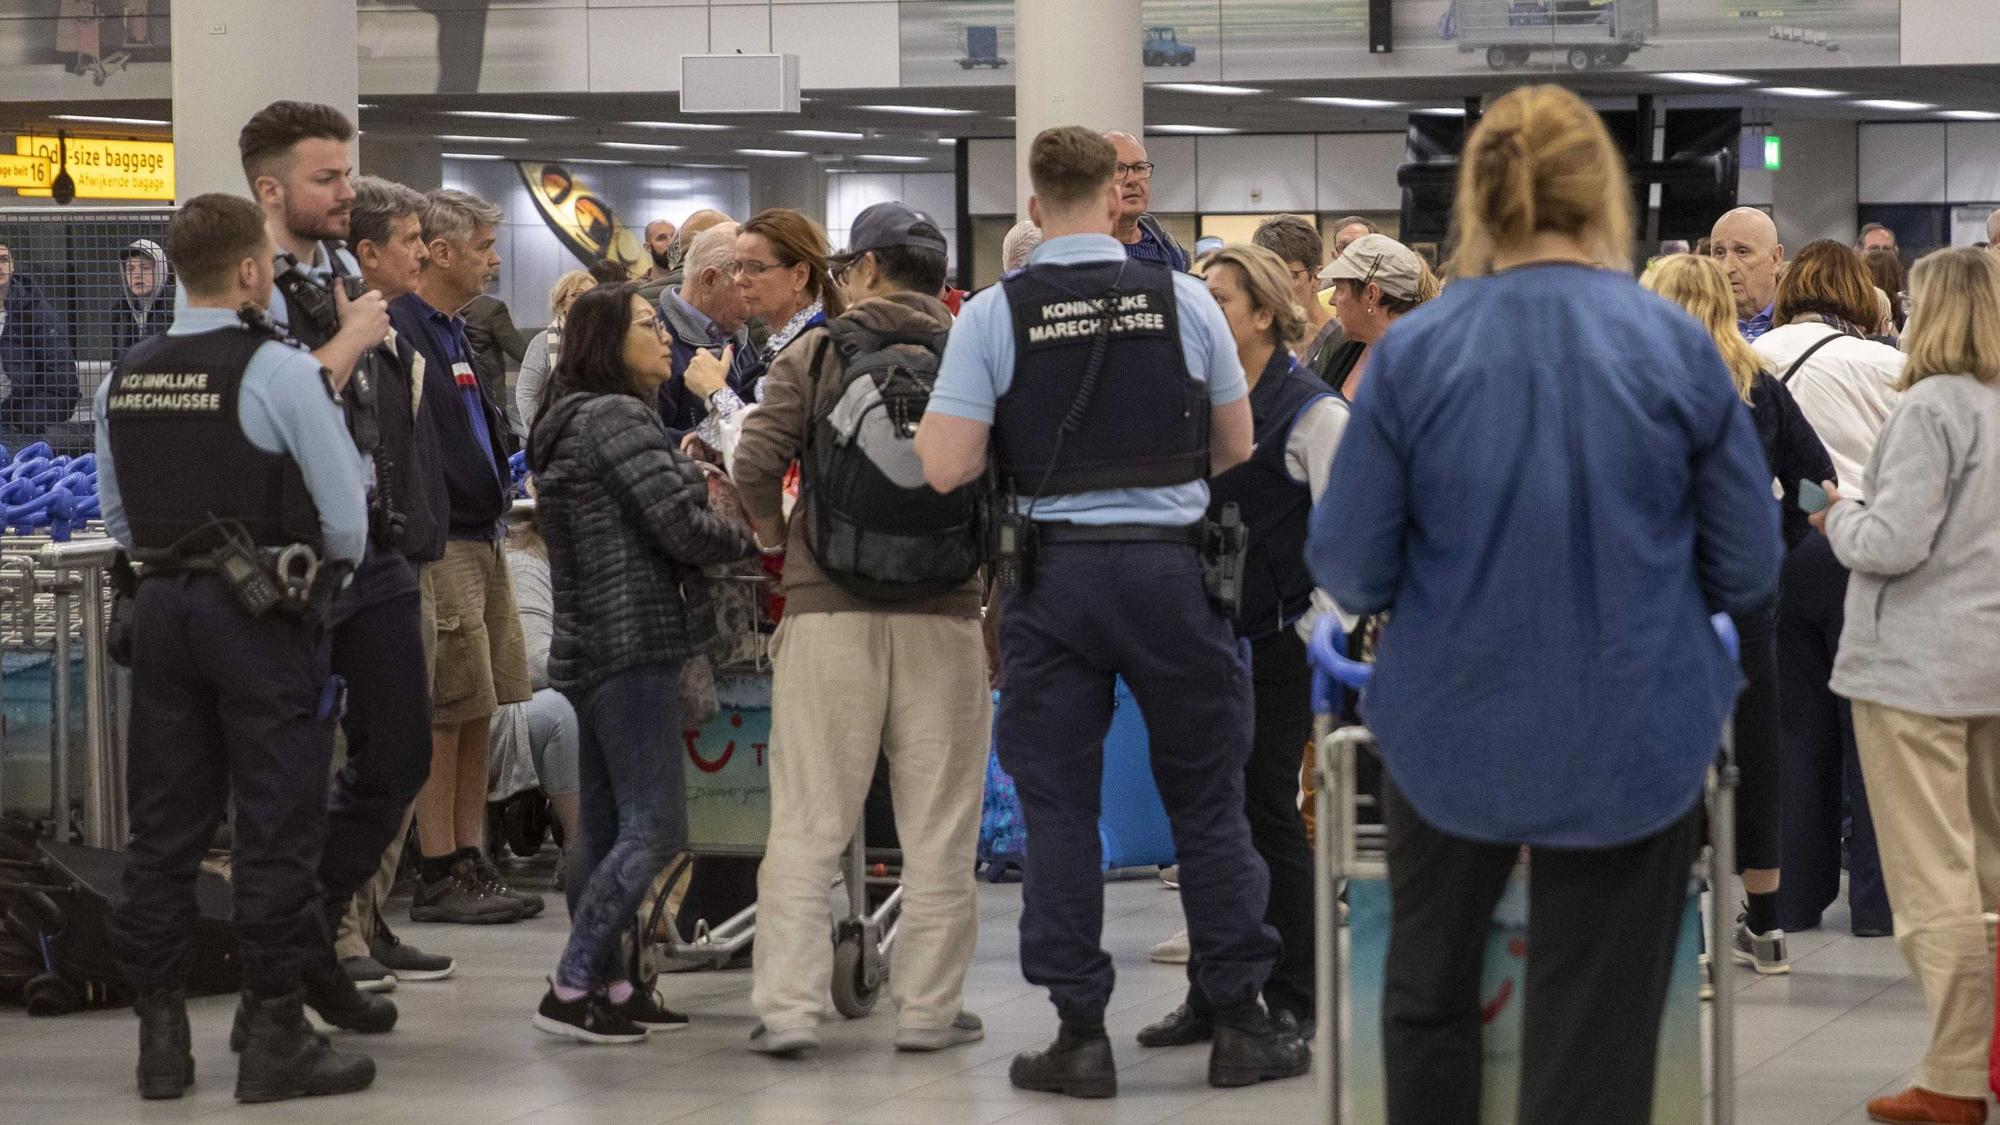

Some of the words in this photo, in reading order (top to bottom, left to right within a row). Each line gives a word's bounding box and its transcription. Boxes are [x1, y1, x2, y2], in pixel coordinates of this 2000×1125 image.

[39, 144, 100, 166] Od-size
[105, 146, 164, 173] baggage
[14, 165, 28, 176] belt
[31, 162, 44, 182] 16
[133, 175, 164, 191] bagage
[1029, 312, 1165, 342] MARECHUSSEE
